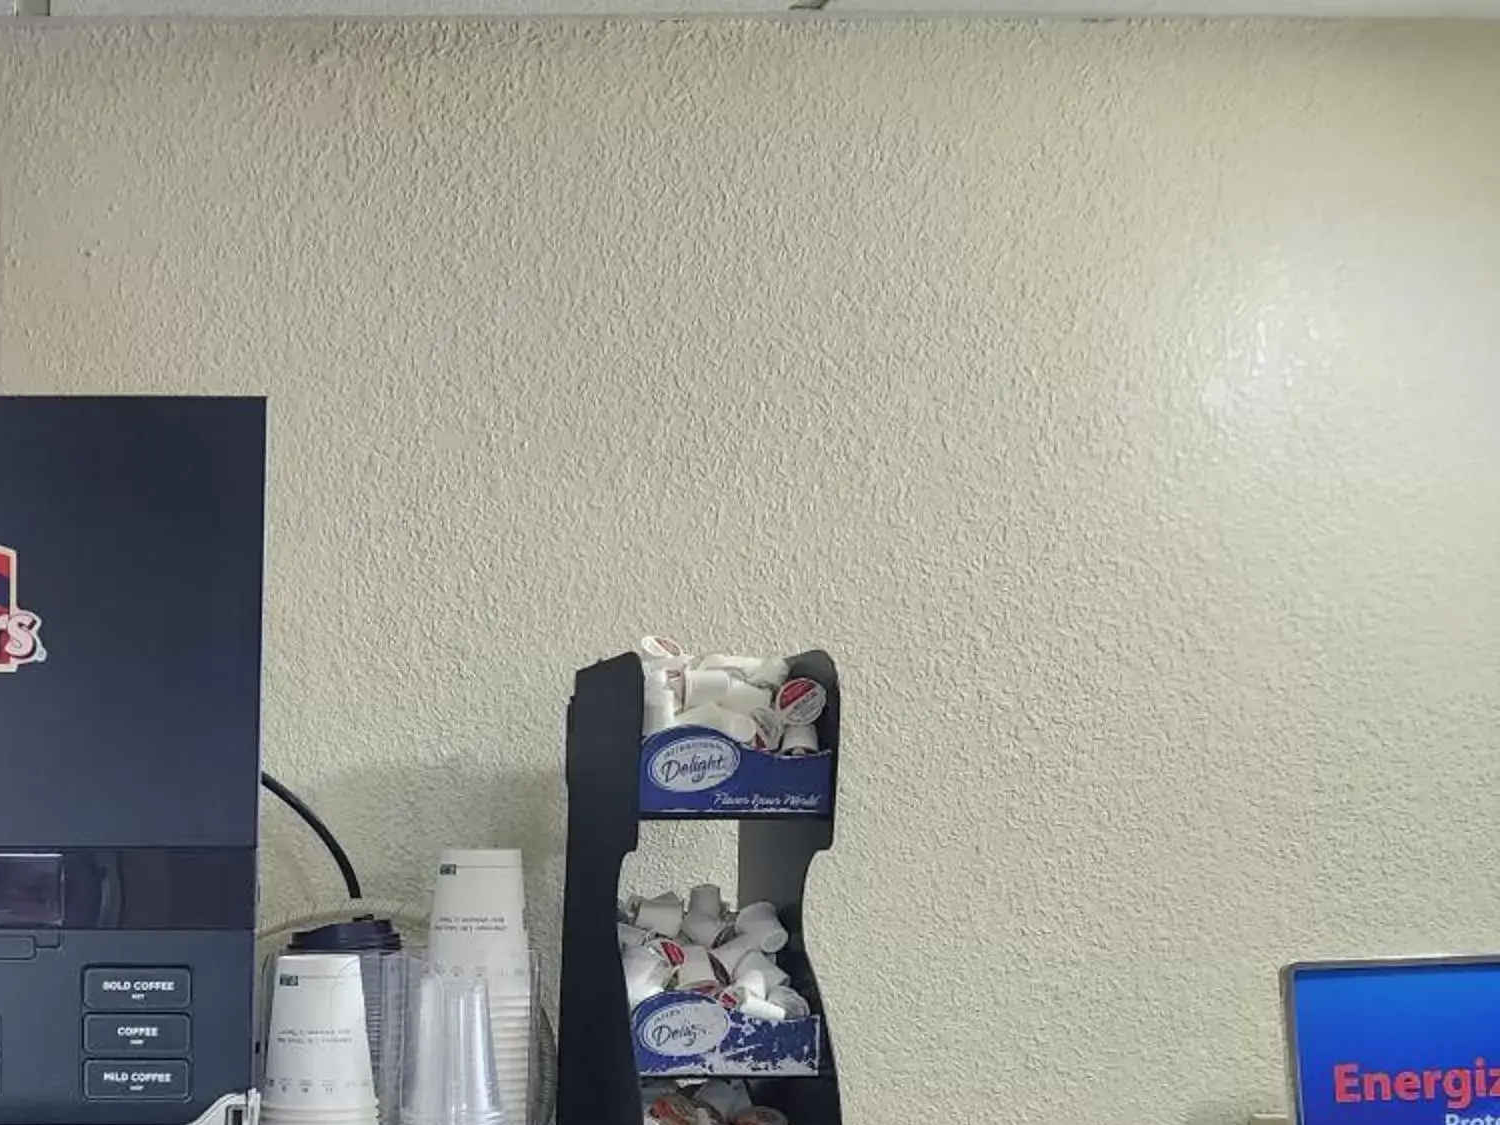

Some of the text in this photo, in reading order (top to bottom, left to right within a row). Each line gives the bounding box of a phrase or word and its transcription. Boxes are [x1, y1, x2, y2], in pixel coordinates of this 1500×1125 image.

[661, 754, 726, 783] Delight
[102, 980, 176, 992] BOLD COFFEE
[116, 1026, 160, 1037] COFFEE
[130, 1071, 173, 1084] COFFEE
